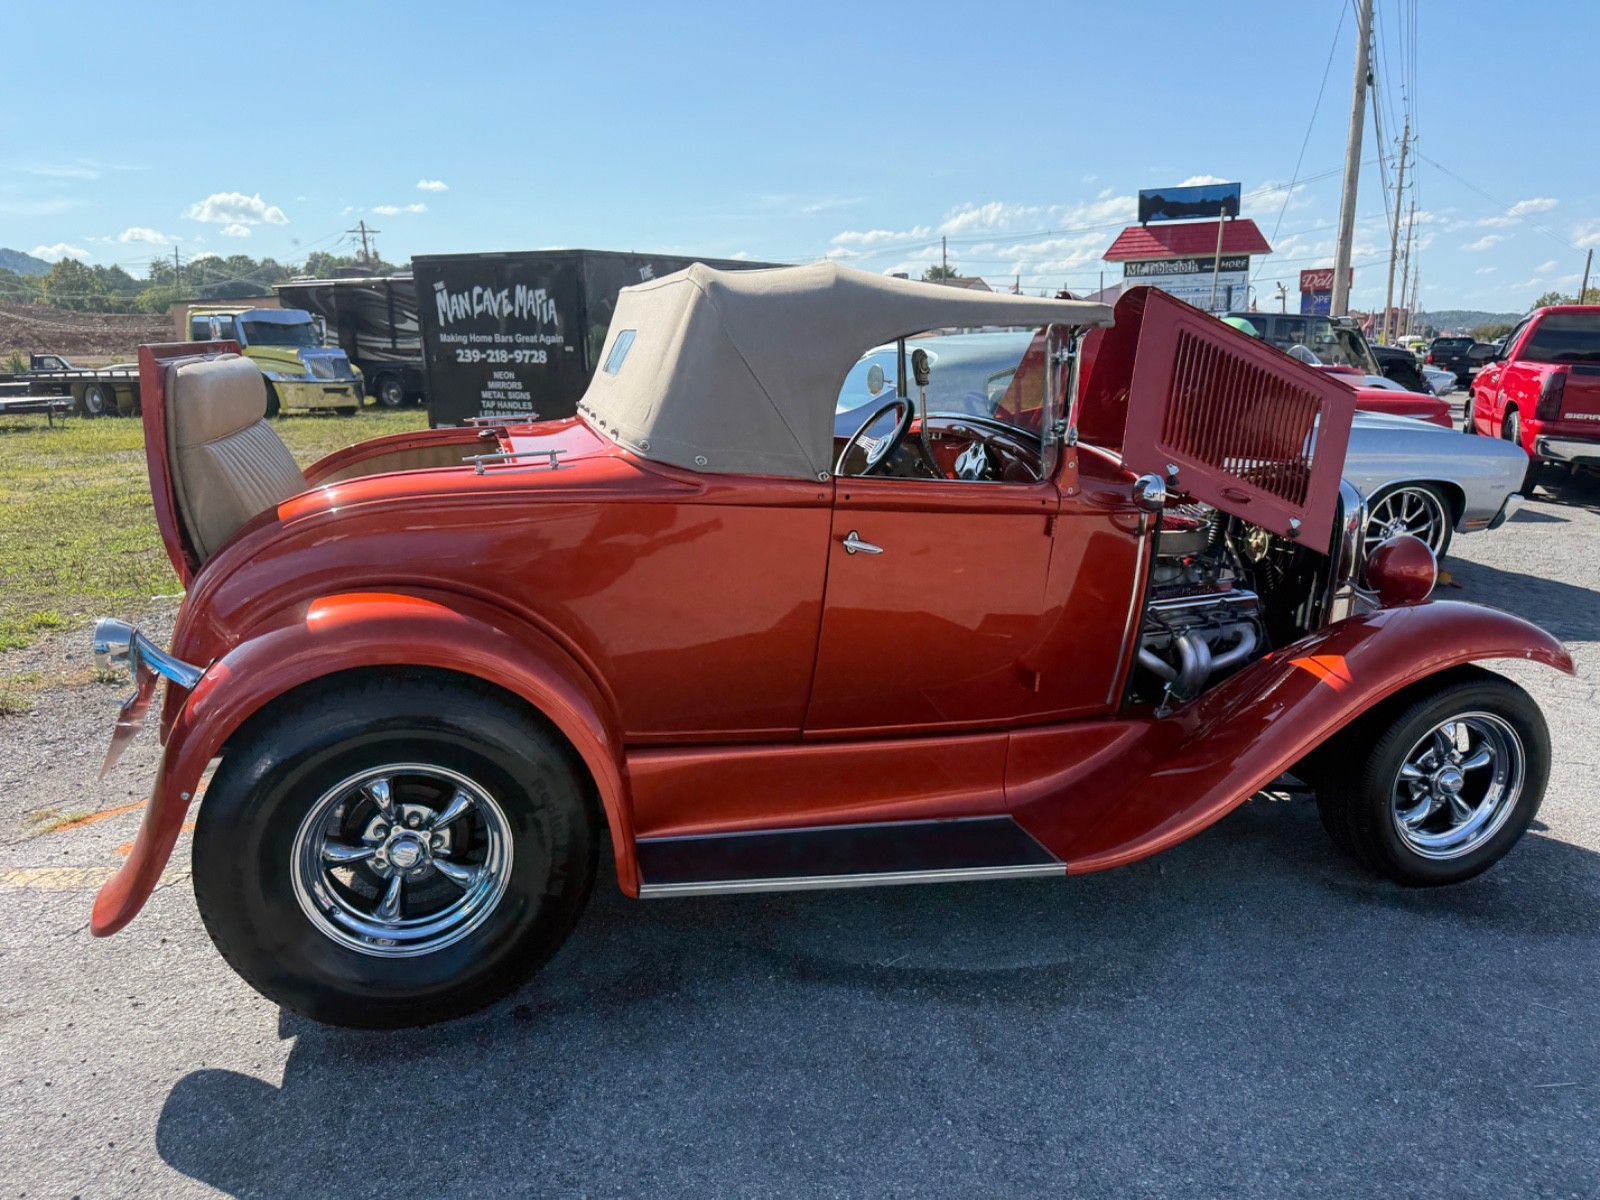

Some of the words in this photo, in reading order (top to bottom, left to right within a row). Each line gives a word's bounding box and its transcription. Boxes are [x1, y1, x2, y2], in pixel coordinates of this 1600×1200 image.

[1221, 259, 1247, 269] MORE
[433, 281, 445, 291] THE
[436, 289, 471, 326] MAN
[473, 286, 513, 319] CAVE
[440, 334, 468, 344] Making
[469, 334, 493, 343] Home
[494, 334, 514, 343] Bars
[515, 334, 538, 343] Great
[539, 334, 564, 345] Again
[456, 348, 547, 363] 239-218-9728
[493, 371, 515, 379] NEON
[487, 381, 522, 389] MIRRORS
[481, 391, 506, 399] METAL
[507, 391, 531, 400] SIGNS
[481, 400, 496, 409] TAP
[497, 401, 532, 410] HANDLES
